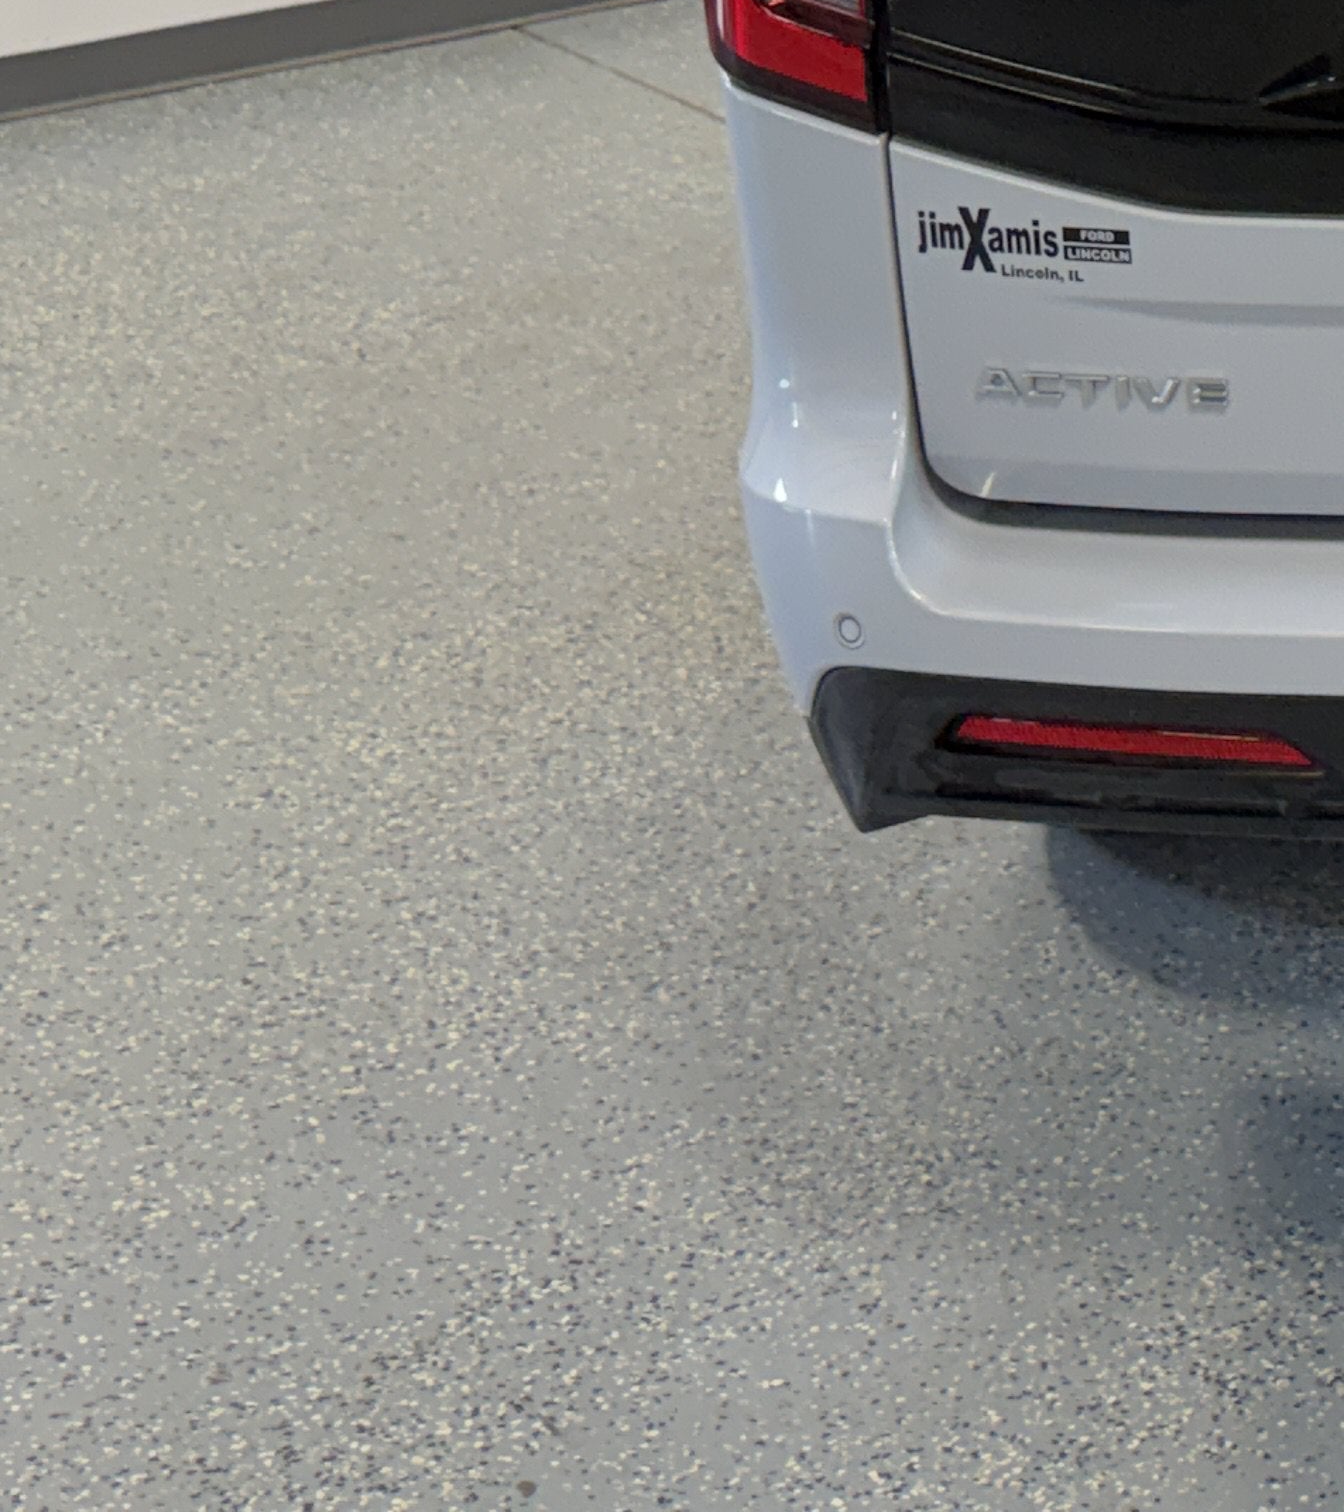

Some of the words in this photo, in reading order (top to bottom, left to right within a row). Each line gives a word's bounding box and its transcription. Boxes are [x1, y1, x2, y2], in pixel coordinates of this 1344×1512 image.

[917, 206, 1058, 273] jimXamis
[1079, 229, 1115, 243] FORD
[1066, 248, 1131, 263] LINCOLN
[1001, 264, 1064, 283] Lincoln,
[1069, 270, 1084, 283] IL
[975, 367, 1229, 413] ACTIVE
